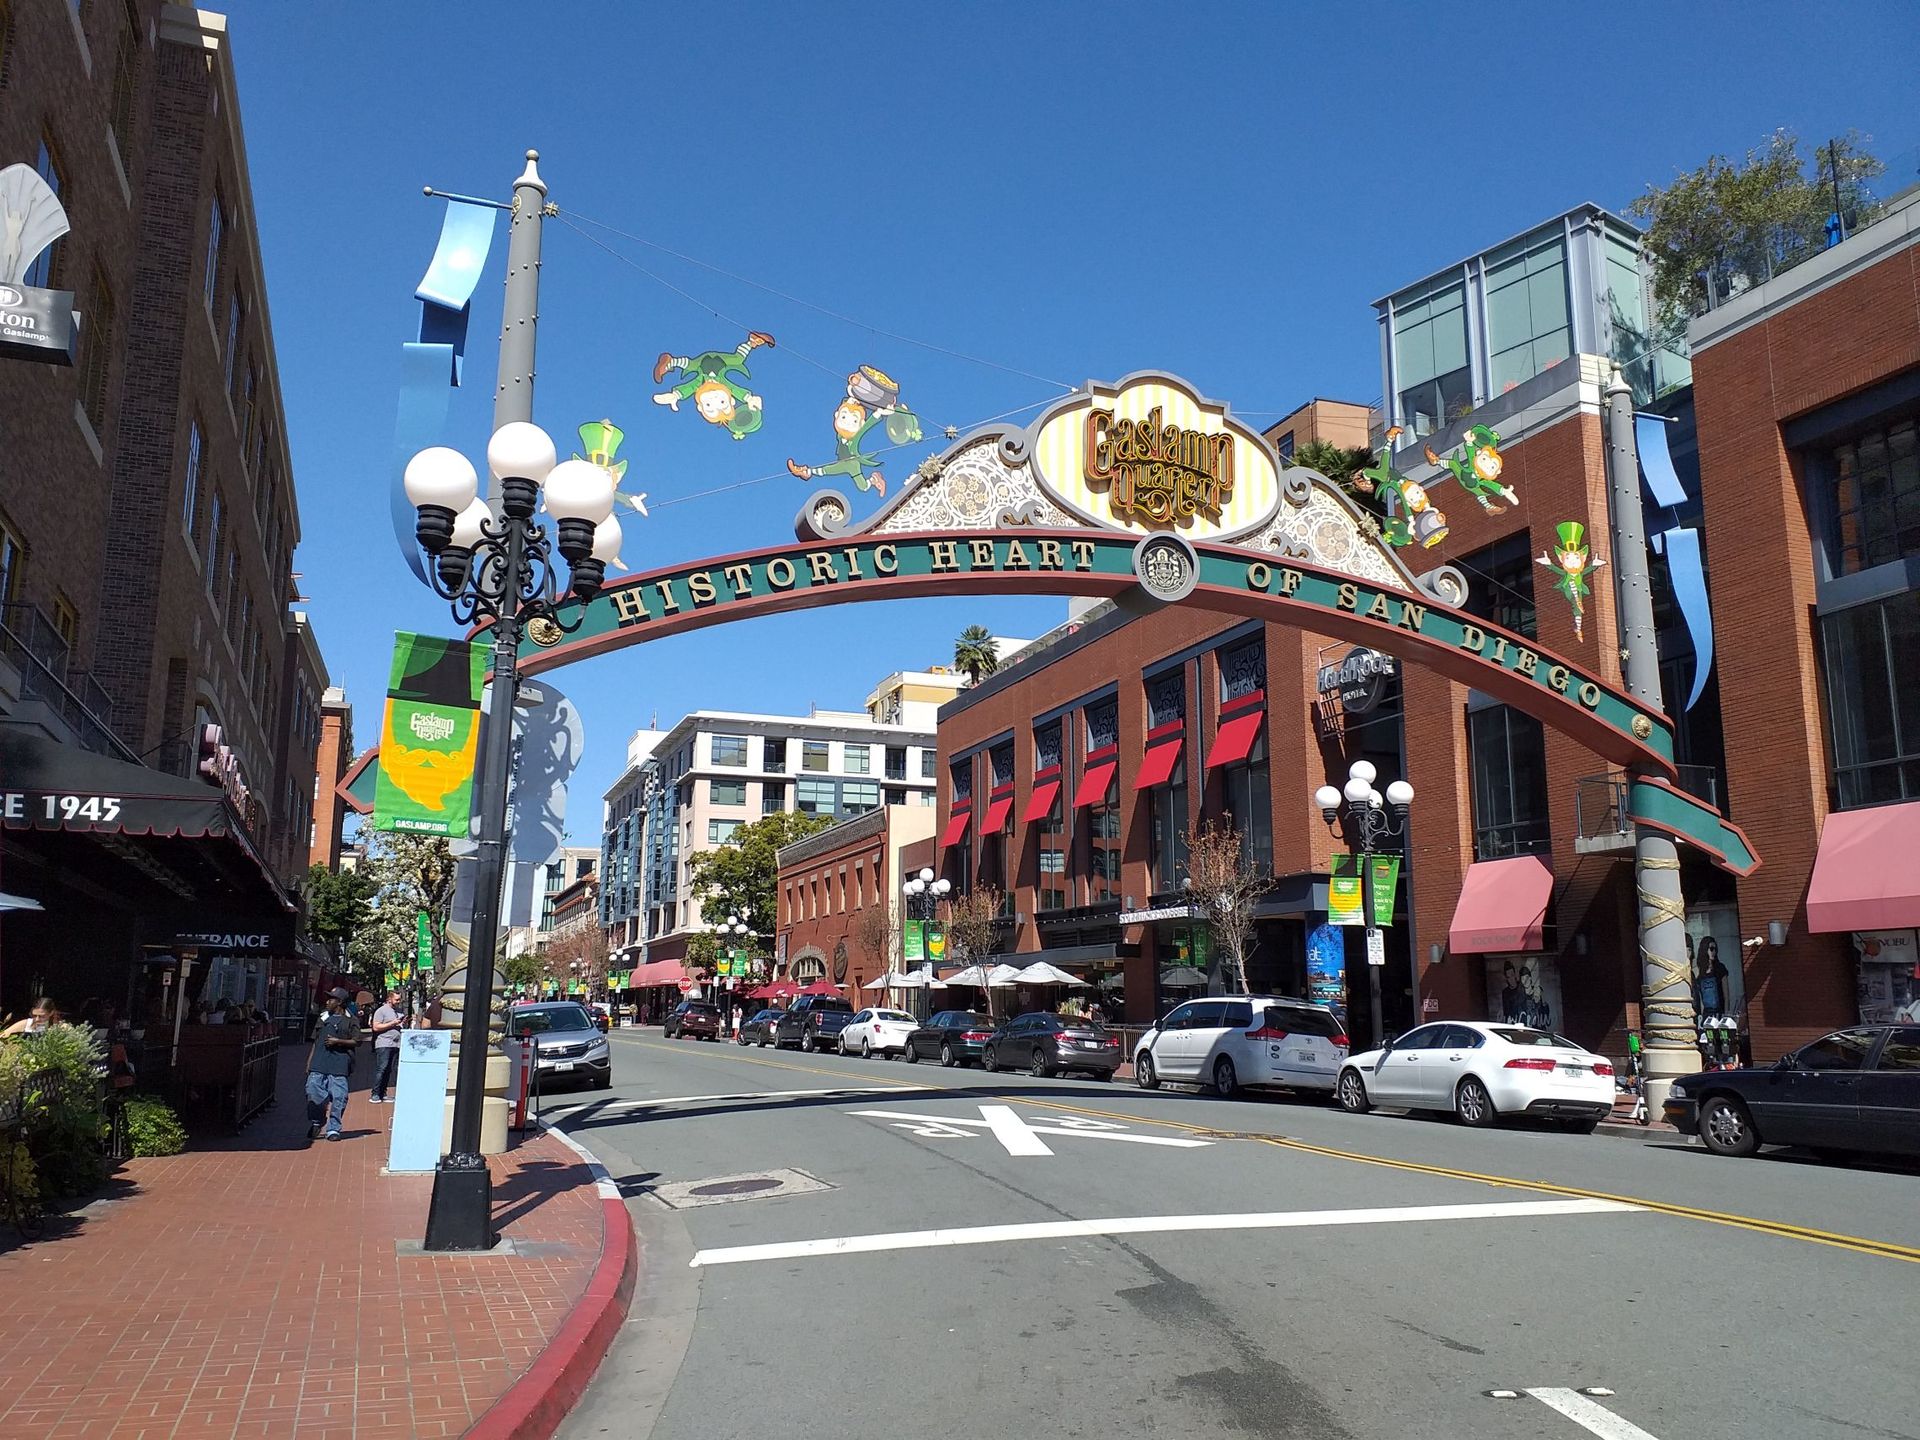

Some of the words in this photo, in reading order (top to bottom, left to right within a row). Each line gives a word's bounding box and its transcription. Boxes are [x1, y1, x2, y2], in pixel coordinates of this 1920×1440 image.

[1086, 405, 1235, 516] Gaslamp
[1112, 462, 1213, 523] Quarter
[610, 544, 899, 622] HISTORIC
[928, 539, 1095, 569] HEART
[1247, 562, 1302, 594] OF
[1337, 583, 1427, 629] SAN
[1459, 624, 1600, 707] DIEGO
[410, 712, 454, 740] Gaslamp
[41, 795, 121, 821] 1945
[395, 820, 448, 832] GASLAMP.ORG
